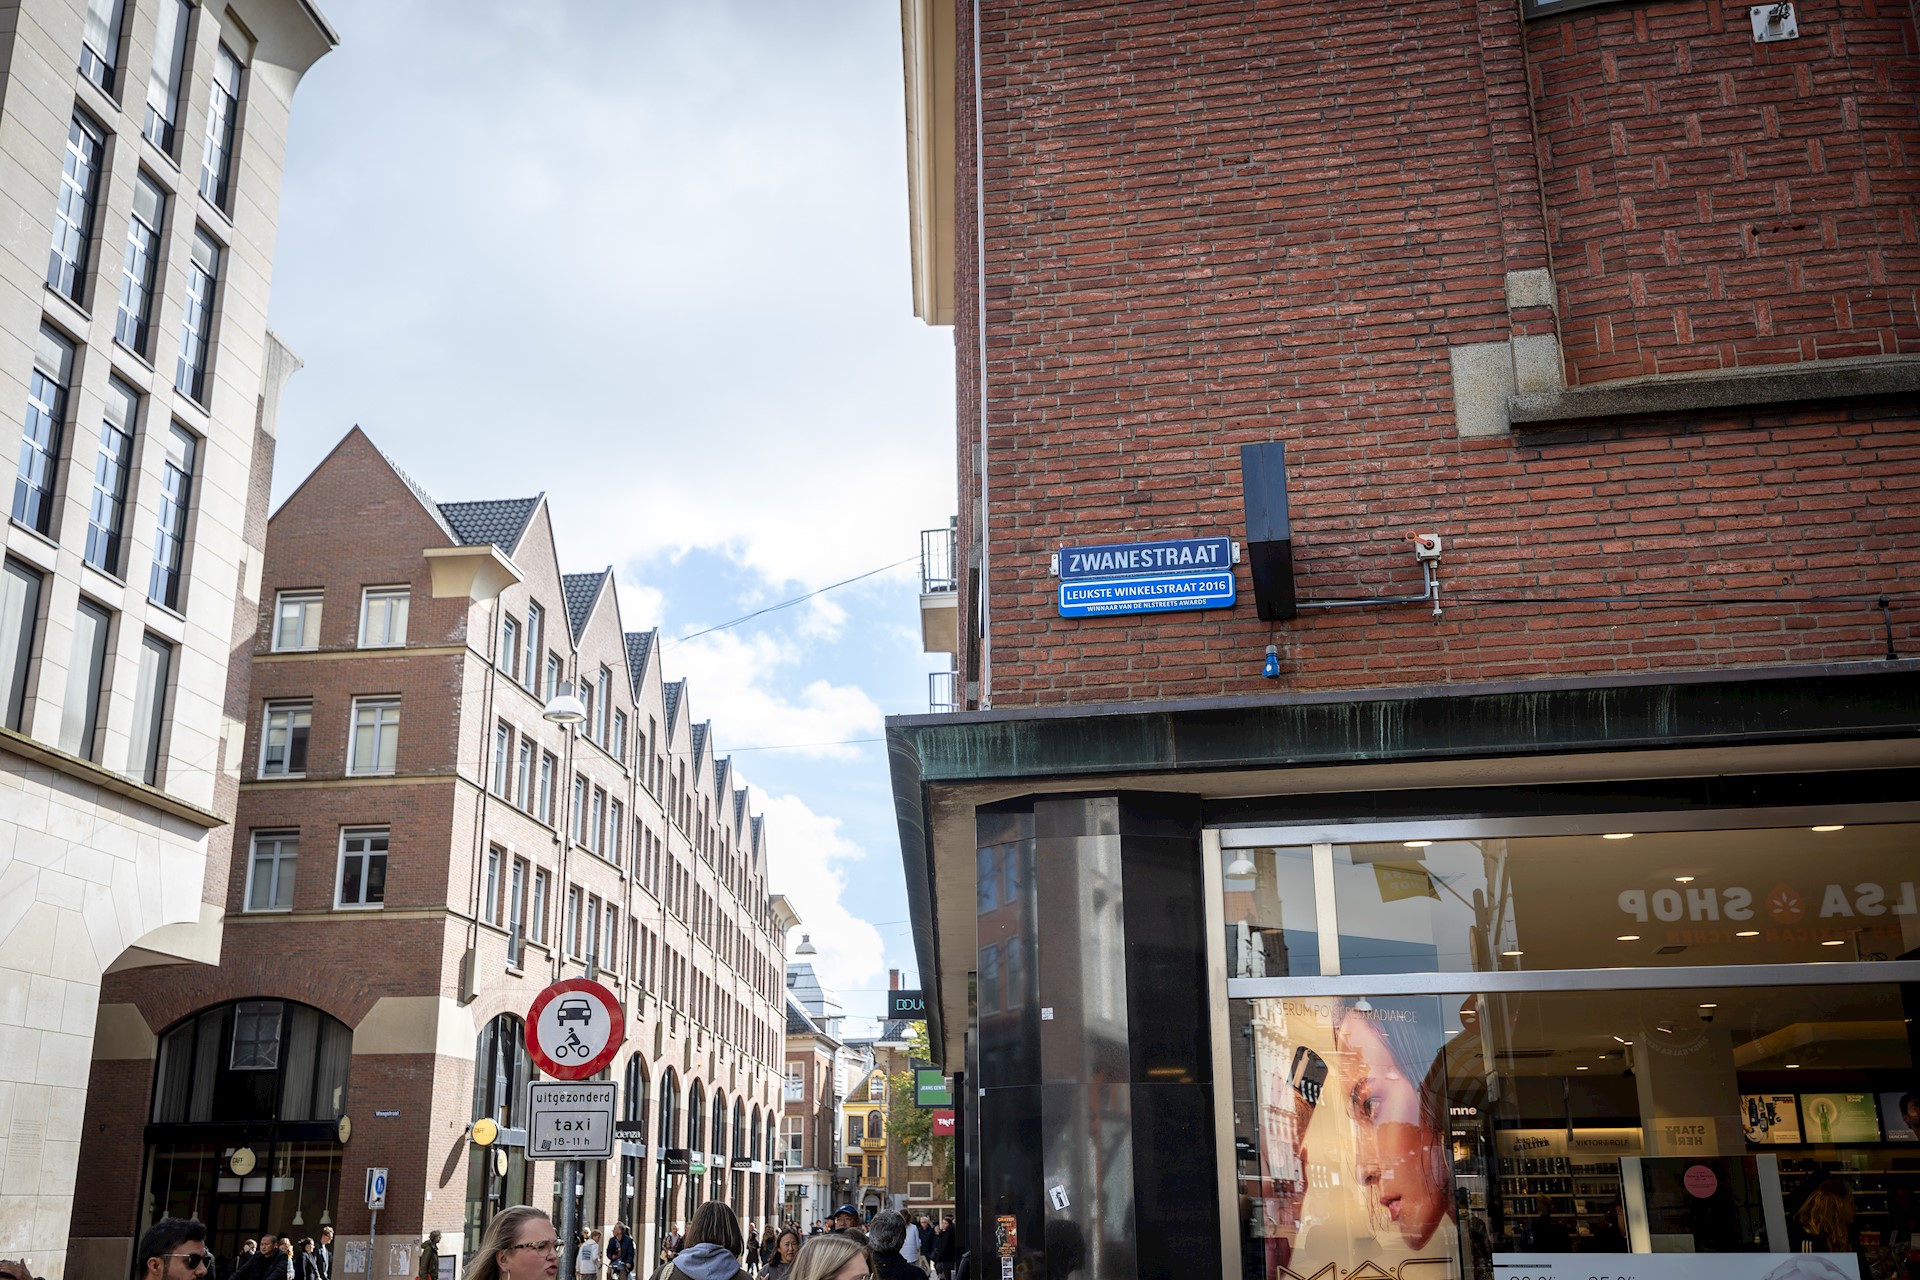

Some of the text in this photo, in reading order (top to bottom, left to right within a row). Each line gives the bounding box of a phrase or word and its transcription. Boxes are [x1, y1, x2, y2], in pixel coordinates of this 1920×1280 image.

[1070, 544, 1219, 572] ZWANESTRAAT
[1067, 581, 1226, 600] LEUKSTE WINKELSTRAAT 2016
[1087, 604, 1118, 612] WINNAAR
[1143, 600, 1178, 608] NLSTREETS
[1179, 598, 1207, 606] AWARDS
[1277, 1003, 1312, 1017] SERUM
[1368, 1008, 1417, 1023] RADIANCE
[537, 1092, 610, 1105] uitgezonderd
[555, 1118, 590, 1131] taxi
[554, 1137, 590, 1146] 18-11 h
